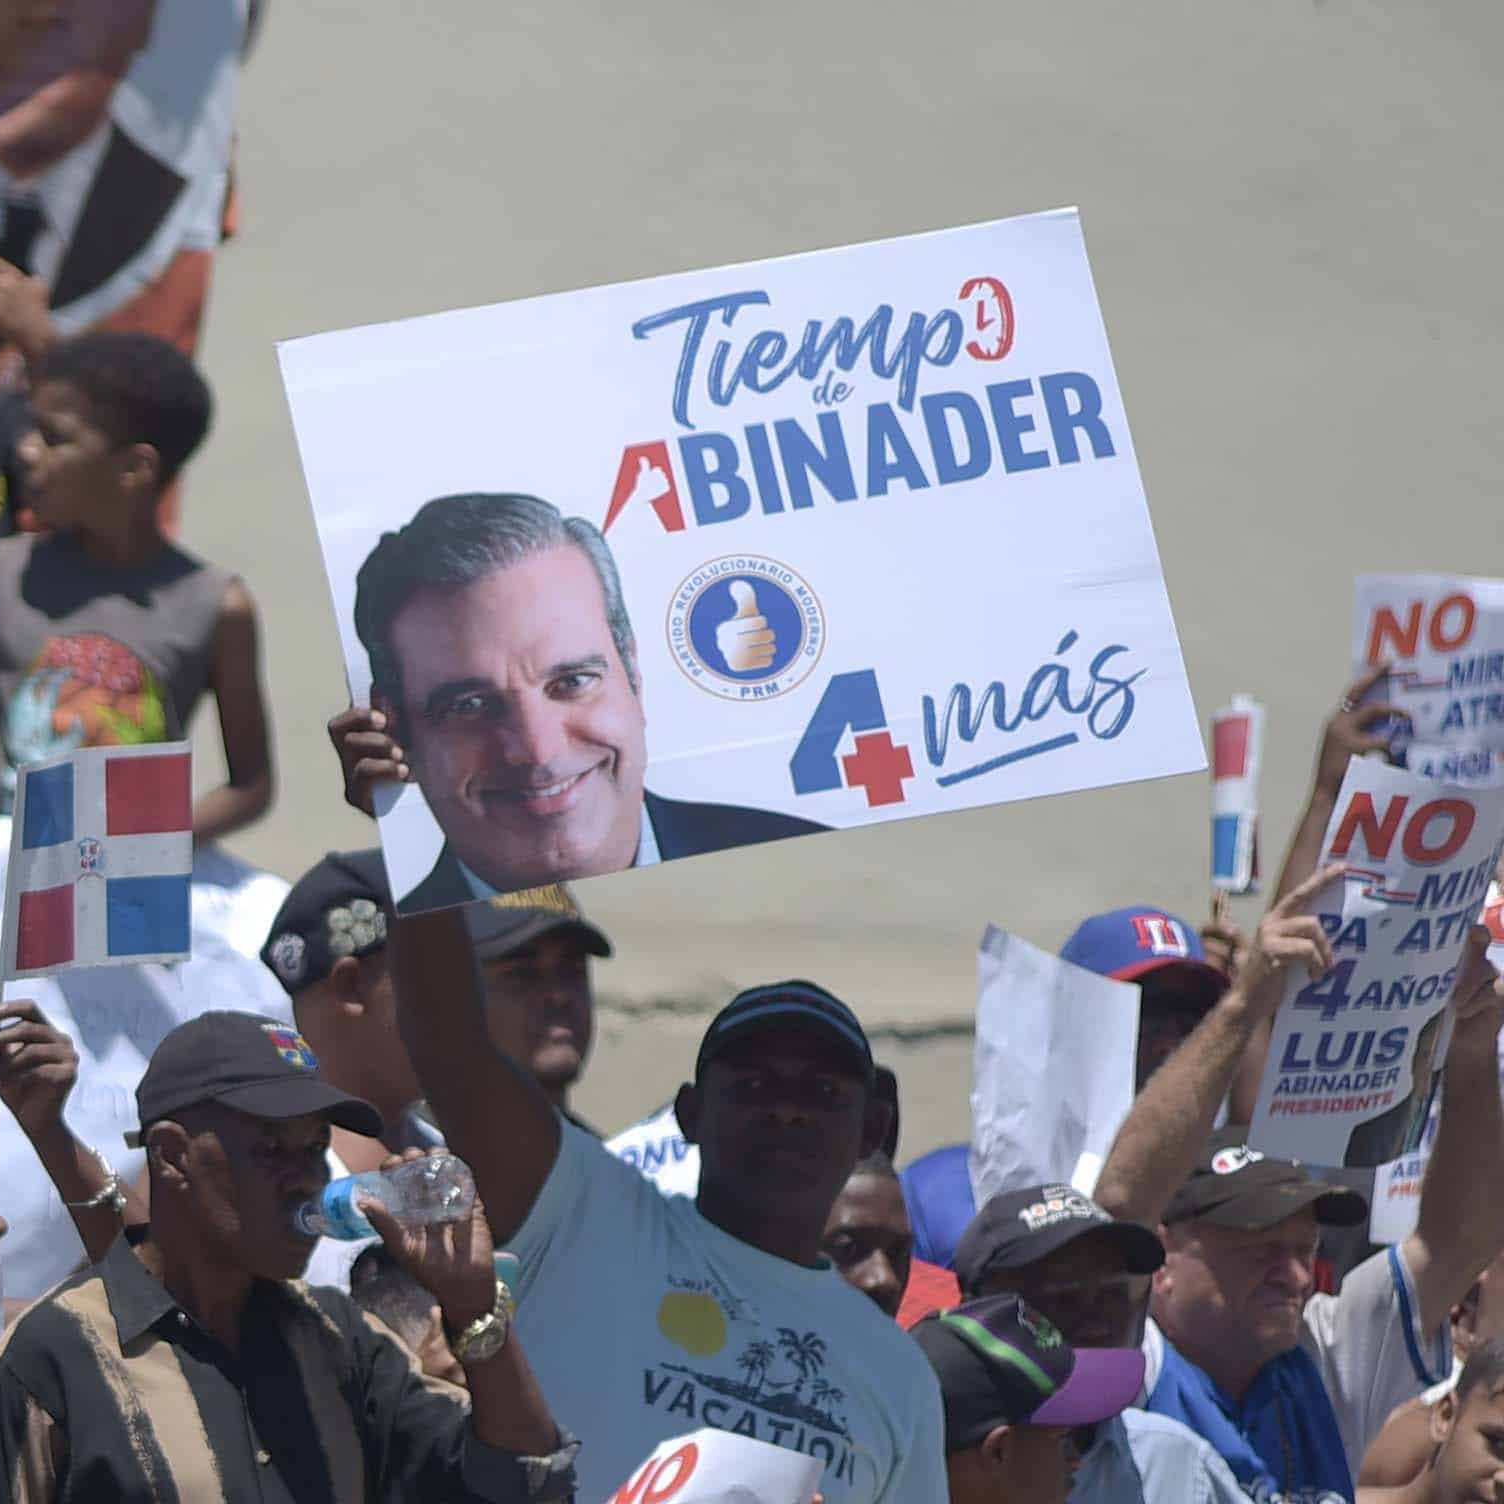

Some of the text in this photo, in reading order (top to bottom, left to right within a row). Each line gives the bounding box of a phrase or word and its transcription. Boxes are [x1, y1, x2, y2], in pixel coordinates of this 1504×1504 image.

[811, 370, 855, 407] de
[602, 371, 1116, 534] ABINADER
[671, 558, 822, 678] PARTIDO REVOLUCIONARIO MODERNO
[1368, 592, 1477, 666] NO
[739, 681, 780, 698] PRM
[921, 628, 1149, 768] más
[1330, 791, 1478, 866] NO
[1295, 958, 1455, 1022] 4 AÑOS
[1273, 1066, 1400, 1098] ABINADER
[1279, 1026, 1410, 1076] LUIS
[1268, 1092, 1396, 1118] PRESIDENTE
